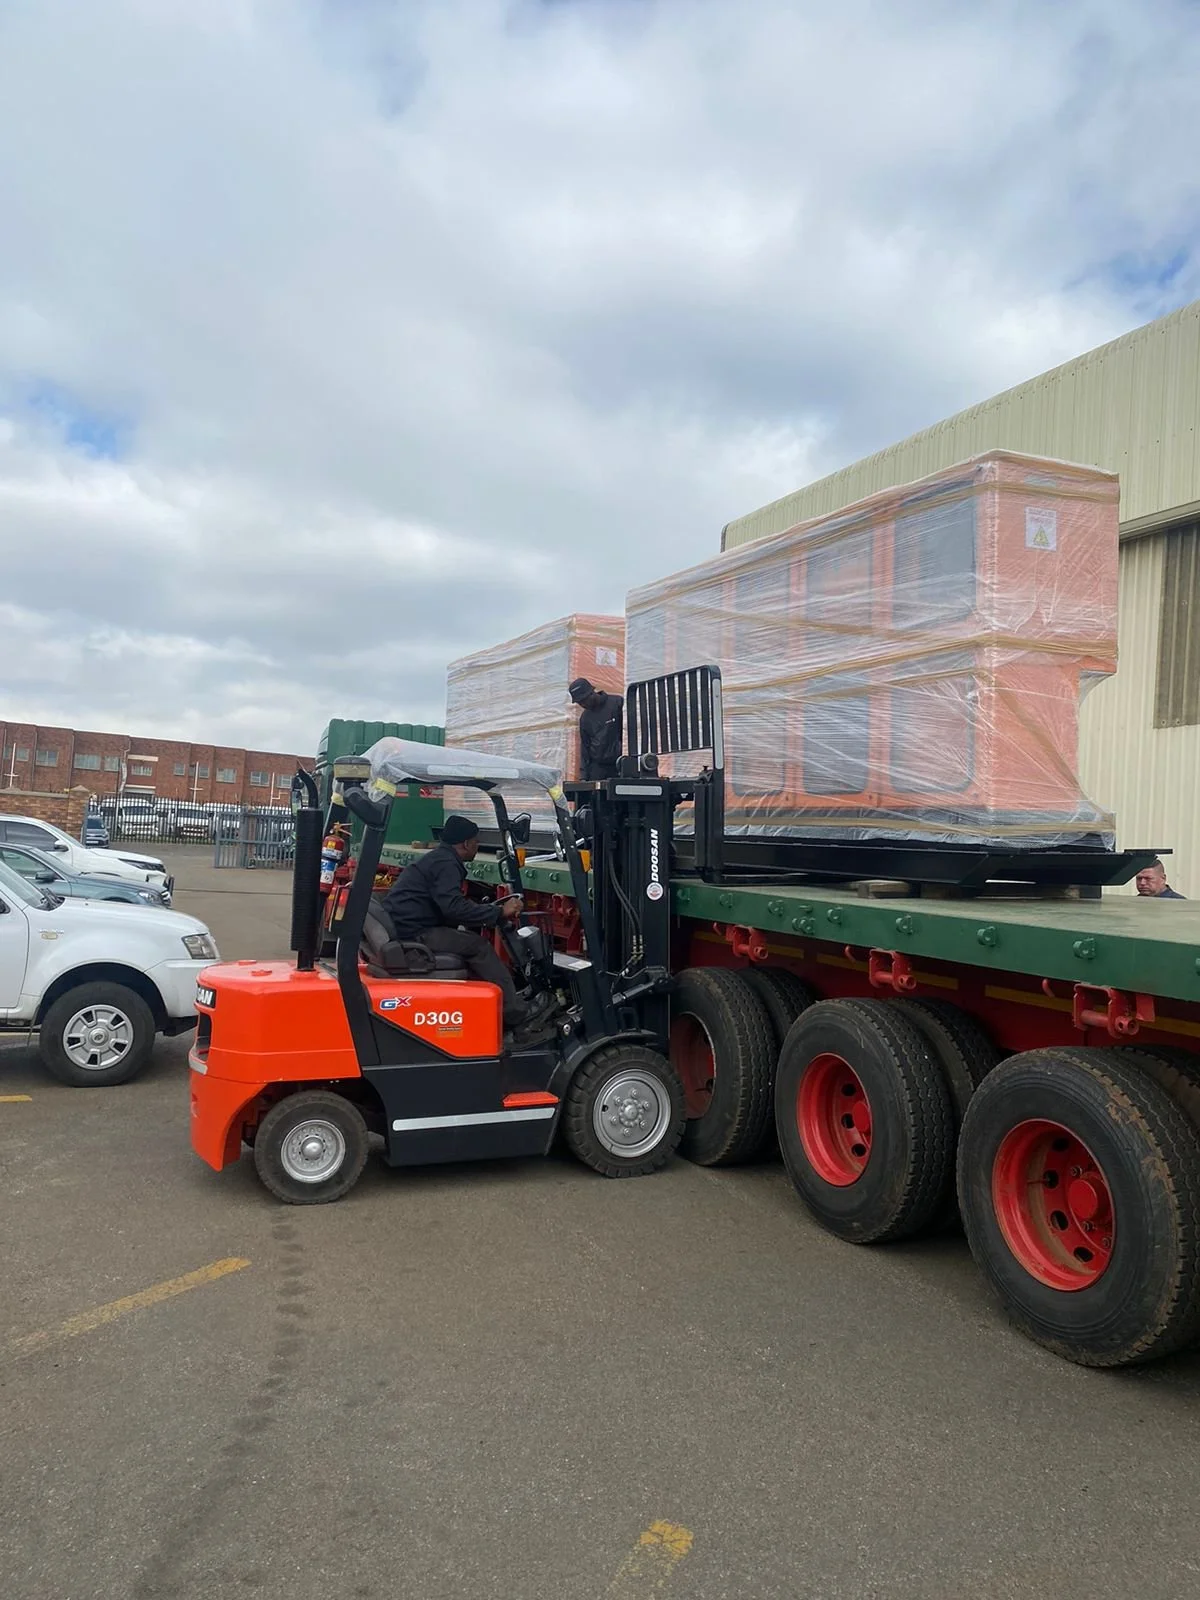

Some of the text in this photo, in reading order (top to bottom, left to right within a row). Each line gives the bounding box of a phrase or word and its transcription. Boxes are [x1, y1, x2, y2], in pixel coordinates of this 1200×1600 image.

[650, 828, 659, 882] DOOSAN
[380, 996, 412, 1010] GX
[414, 1011, 463, 1026] D30G
